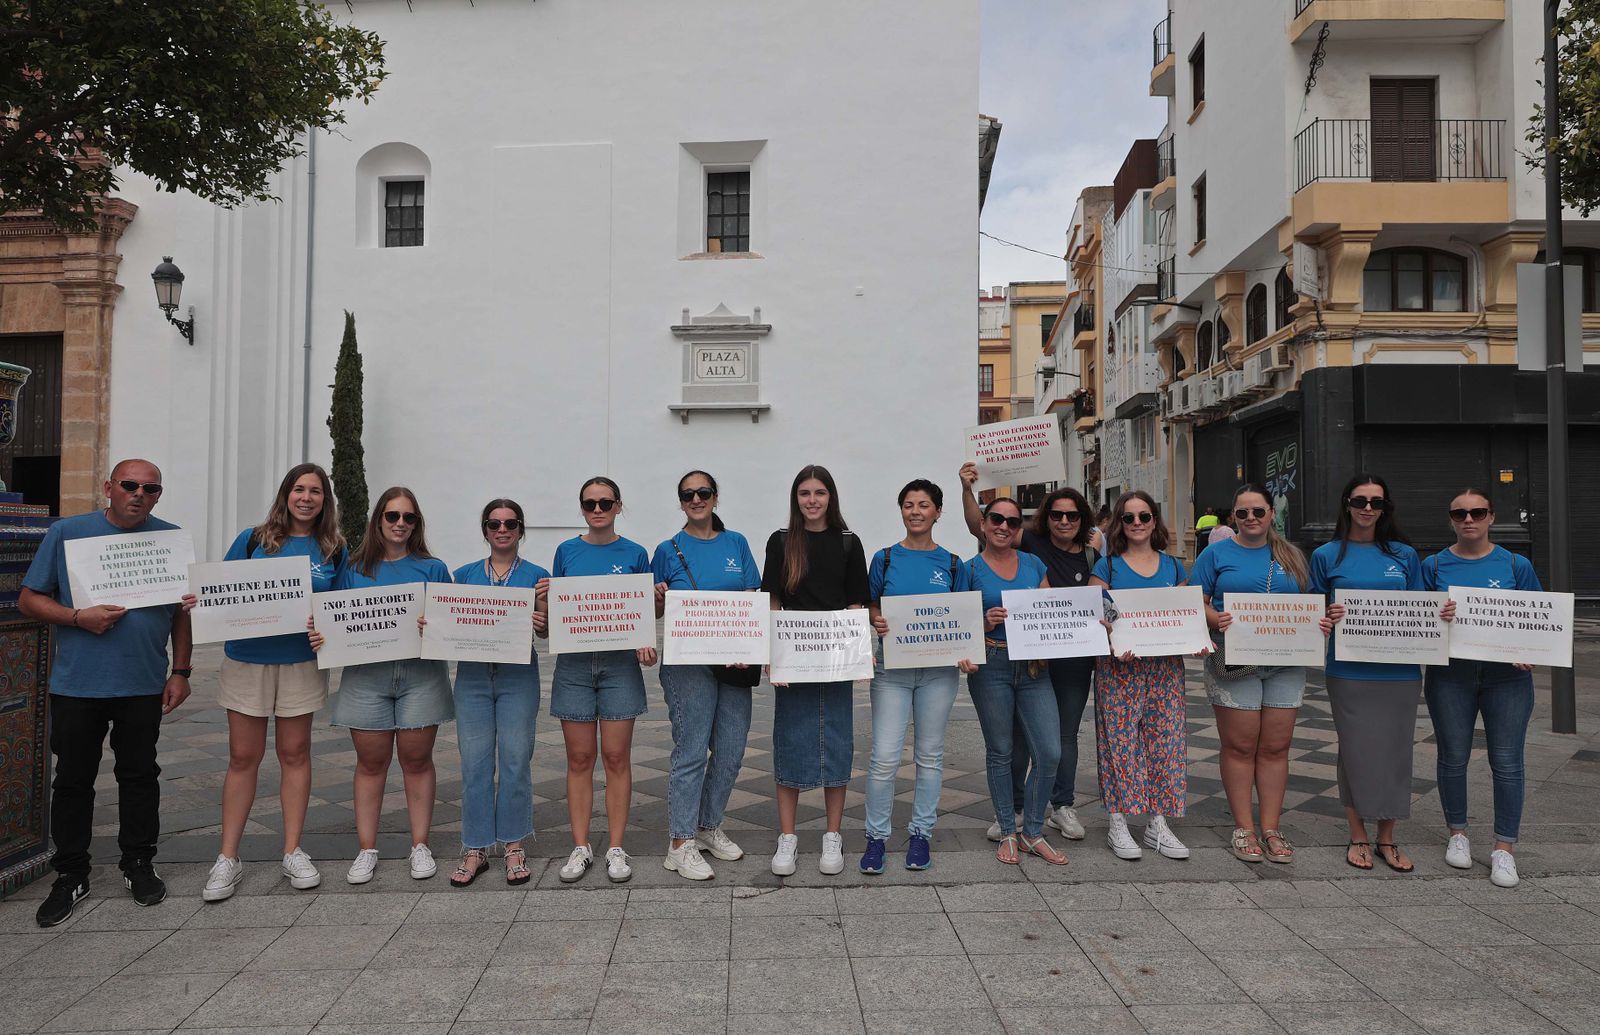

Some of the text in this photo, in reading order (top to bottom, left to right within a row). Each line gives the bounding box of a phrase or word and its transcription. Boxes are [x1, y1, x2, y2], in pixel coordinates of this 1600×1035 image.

[702, 352, 739, 361] PLAZA
[706, 366, 735, 375] ALTA
[988, 430, 1009, 438] APOYO
[997, 432, 1046, 444] ASOCIACIONES
[1011, 450, 1040, 459] DROGAS!
[1266, 442, 1297, 478] EVO
[106, 540, 156, 551] ¡EXIGIMOS!
[102, 560, 153, 570] INMEDIATA
[90, 574, 187, 591] JUSTICIA UNIVERSAL
[201, 579, 300, 594] PREVIENE EL VIH
[200, 596, 239, 607] ¡HAZTE
[258, 591, 304, 601] PRUEBA!
[585, 592, 618, 600] CIERRE
[324, 593, 414, 610] ¡NO! AL RECORTE
[1033, 600, 1072, 609] CENTROS
[1467, 596, 1526, 607] UNÁMONOS
[578, 603, 612, 612] UNIDAD
[1231, 602, 1303, 611] ALTERNATIVAS
[334, 607, 407, 622] DE POLÍTICAS
[450, 607, 494, 616] ENFERMOS
[914, 607, 950, 617] TOD@S
[1013, 610, 1069, 620] ESPECÍFICOS
[1120, 609, 1198, 619] ARCOTRAFICANTES
[1469, 608, 1504, 617] LUCHA
[562, 611, 641, 623] DESINTOXICACIÓN
[346, 620, 397, 633] SOCIALES
[675, 619, 746, 627] REHABILITACIÓN
[777, 619, 829, 628] PATOLOGÍA
[906, 622, 945, 631] CONTRA
[1041, 621, 1087, 630] ENFERMOS
[1346, 619, 1422, 628] REHABILITACIÓN
[1456, 617, 1493, 627] MUNDO
[1518, 622, 1563, 632] DROGAS
[570, 624, 635, 634] HOSPITALARIA
[1254, 626, 1297, 635] JÓVENES
[1342, 629, 1440, 638] DROGODEPENDIENTES
[794, 631, 846, 640] PROBLEMA
[896, 632, 971, 644] NARCOTRAFICO
[1040, 632, 1073, 640] DUALES
